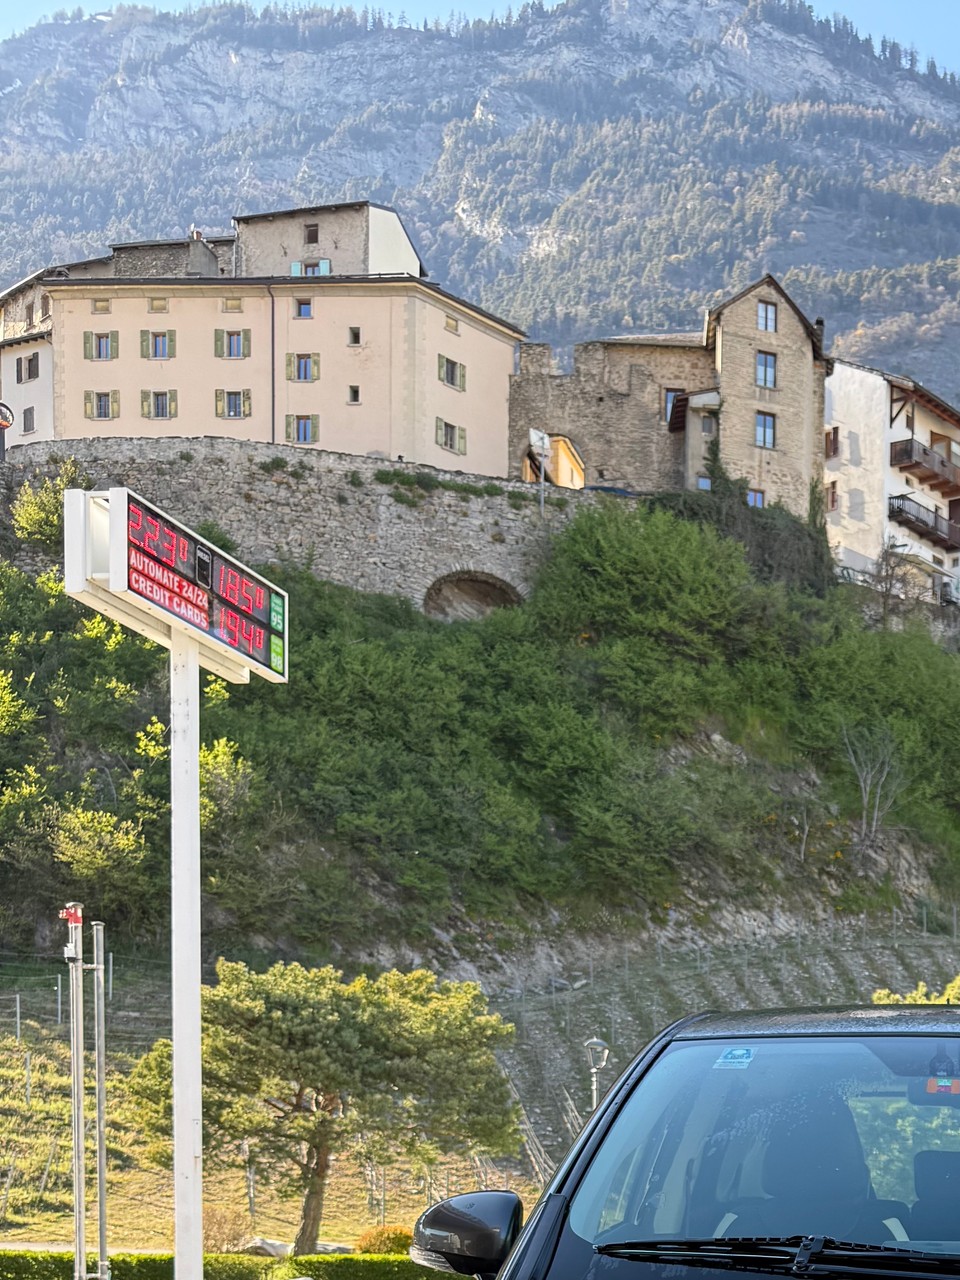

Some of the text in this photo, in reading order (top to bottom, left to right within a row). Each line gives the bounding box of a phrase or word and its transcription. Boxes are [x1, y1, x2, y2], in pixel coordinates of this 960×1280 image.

[129, 550, 208, 609] AUTOMATE 24/24
[131, 572, 208, 628] CREDIT CARDS
[270, 611, 283, 630] 95
